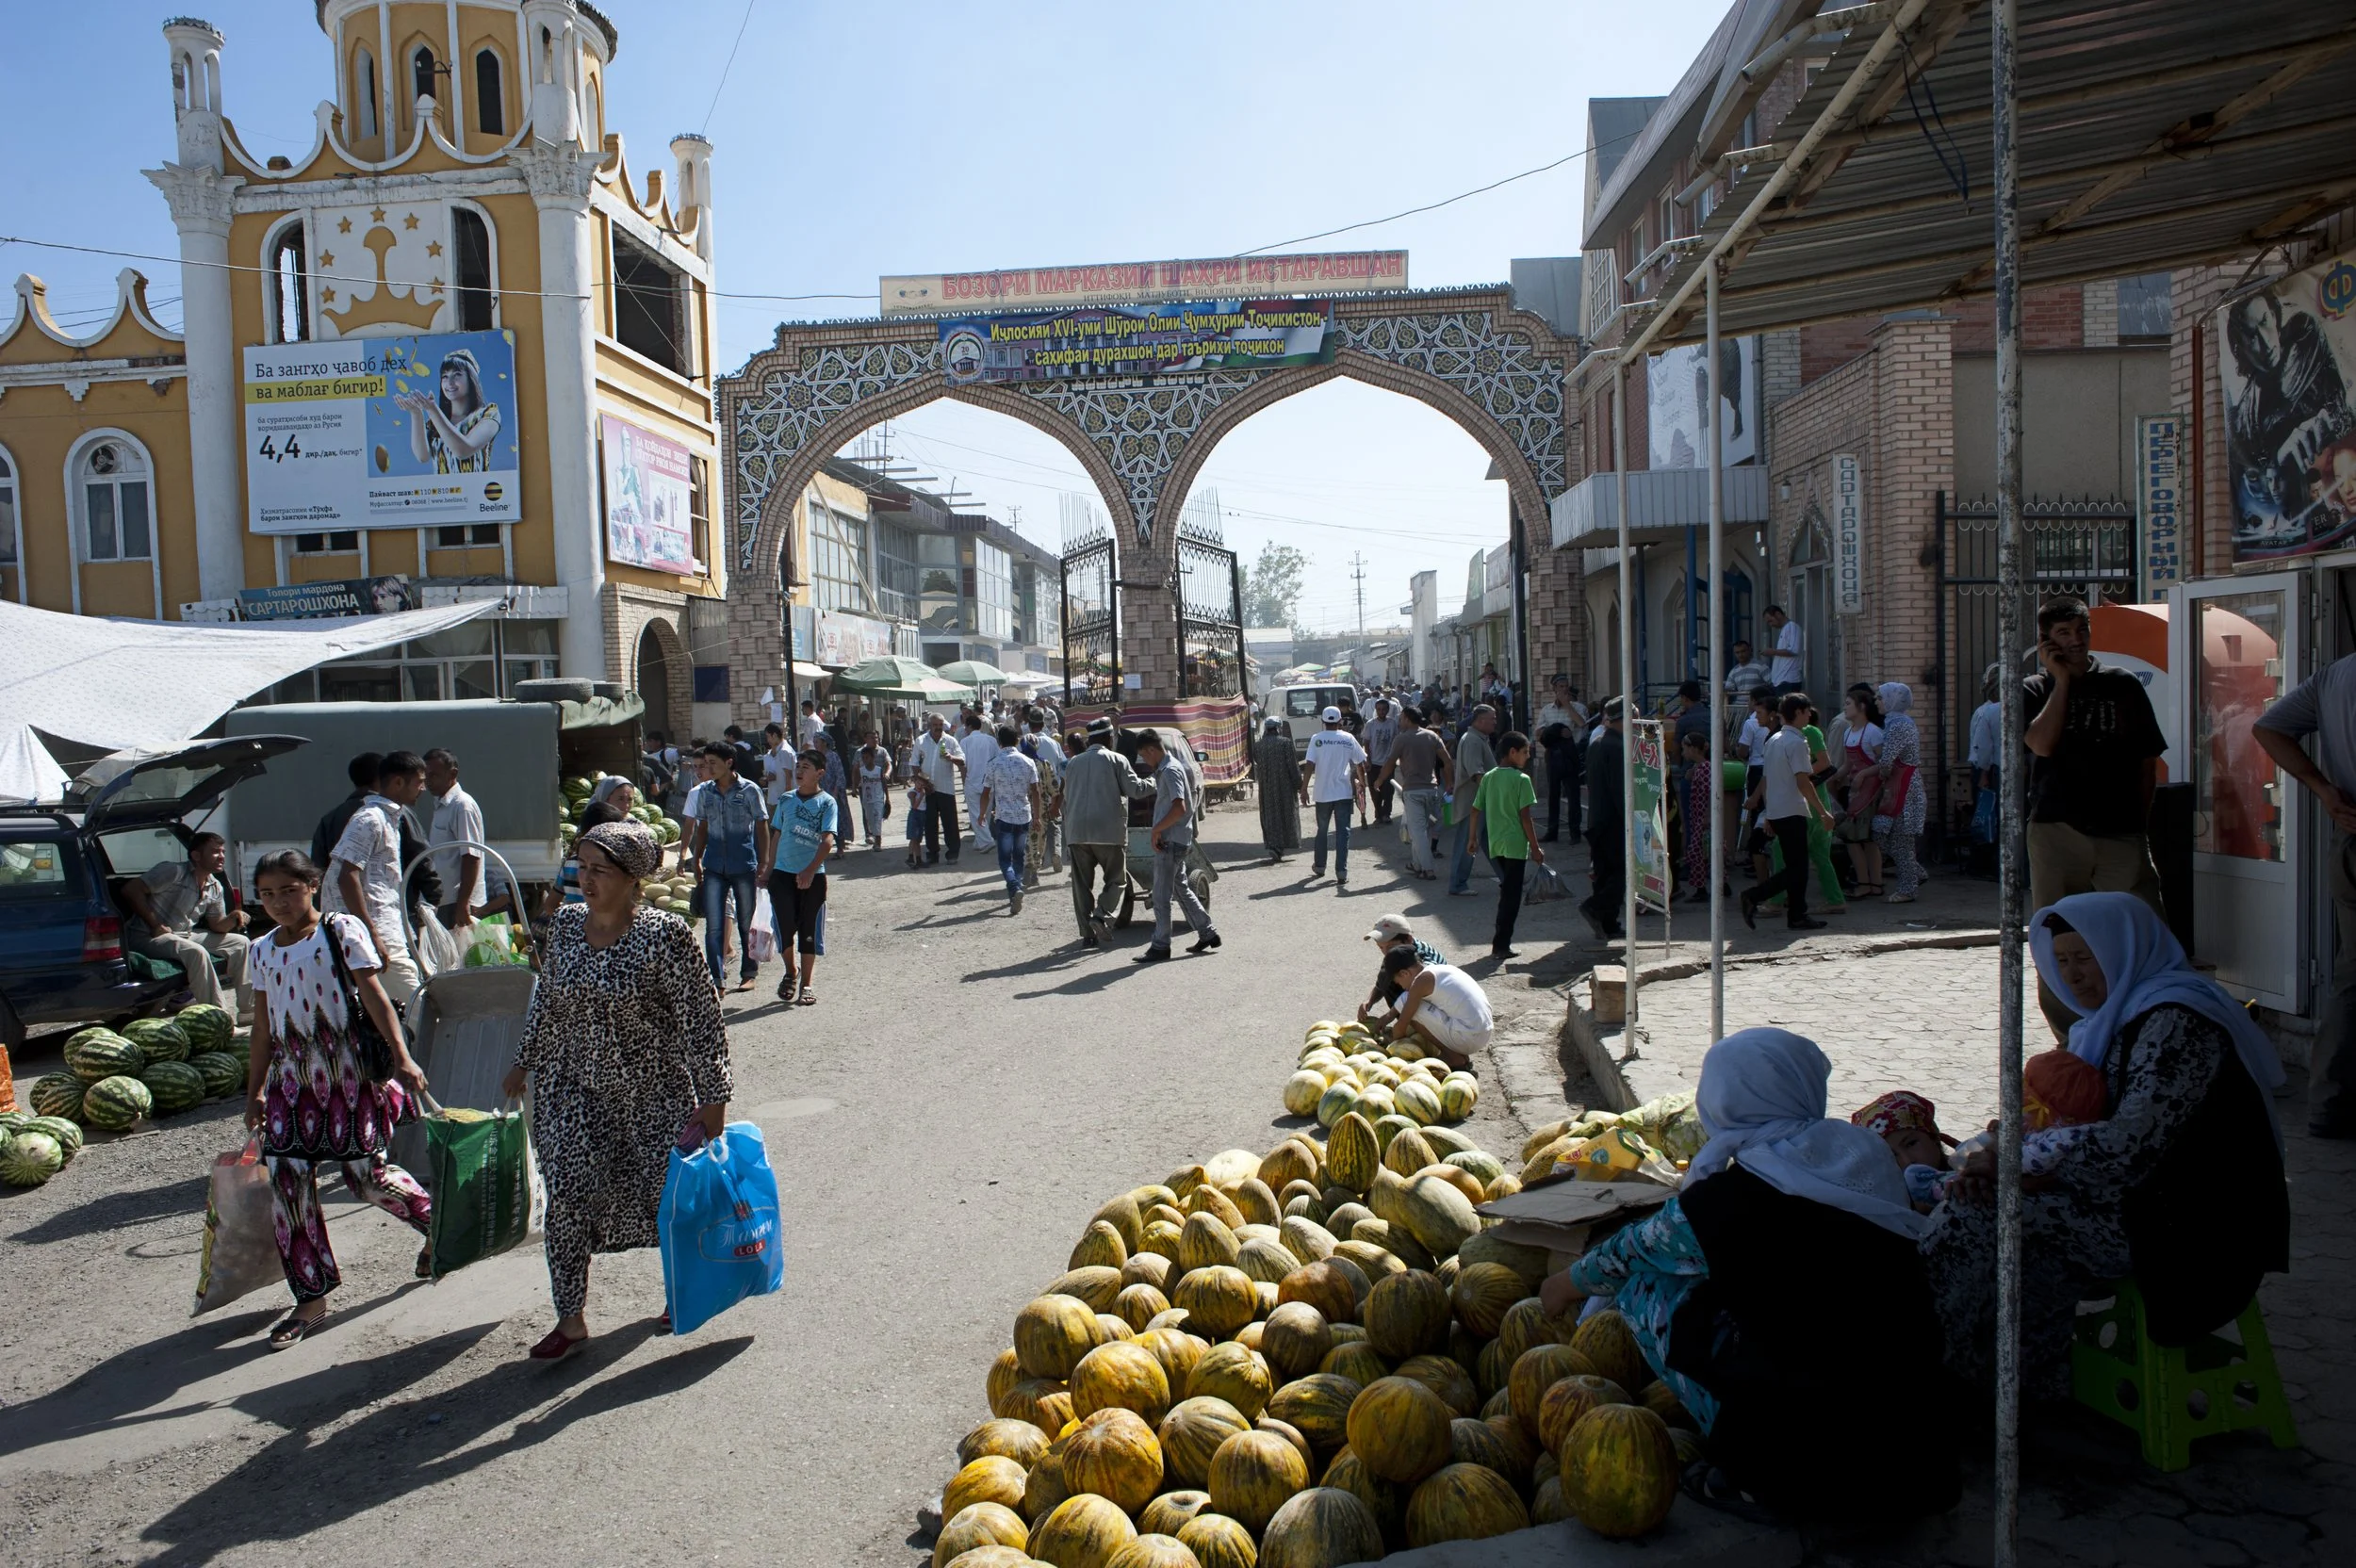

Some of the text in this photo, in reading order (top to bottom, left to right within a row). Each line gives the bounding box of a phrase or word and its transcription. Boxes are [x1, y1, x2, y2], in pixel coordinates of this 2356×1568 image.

[942, 251, 1402, 300] БОЗОРИ МАРКАЗИИ ШАҲРИ ИСТАРАВШАН
[1195, 286, 1235, 296] ВИЛОЯТИ
[990, 323, 1051, 344] Иҷлосияи
[1054, 317, 1102, 341] XVI-уми
[1104, 316, 1145, 339] Шӯрои
[1149, 312, 1181, 333] Олии
[1184, 310, 1245, 334] Ҷумҳурии
[1248, 309, 1320, 331] Тоҷикистон
[1036, 338, 1284, 368] саҳифаи дурахшон дар таърихи тоҷикон
[255, 356, 407, 378] Ба зангҳо ҷавоб деҳ
[256, 378, 384, 399] ва маблағ бигир!
[257, 416, 265, 424] ба
[322, 414, 342, 423] барои
[322, 420, 342, 430] Русия
[259, 433, 301, 464] 4,4
[369, 490, 396, 498] Пайваст
[431, 496, 468, 504] www.beeline.tj
[2149, 422, 2179, 580] ПЕРЕГОВОРНЫЙ
[260, 514, 280, 523] барои
[480, 503, 509, 513] Beeline
[1840, 457, 1858, 604] САРТАРОШХОНА
[303, 583, 346, 596] мардона
[248, 593, 360, 617] САРТАРОШХОНА
